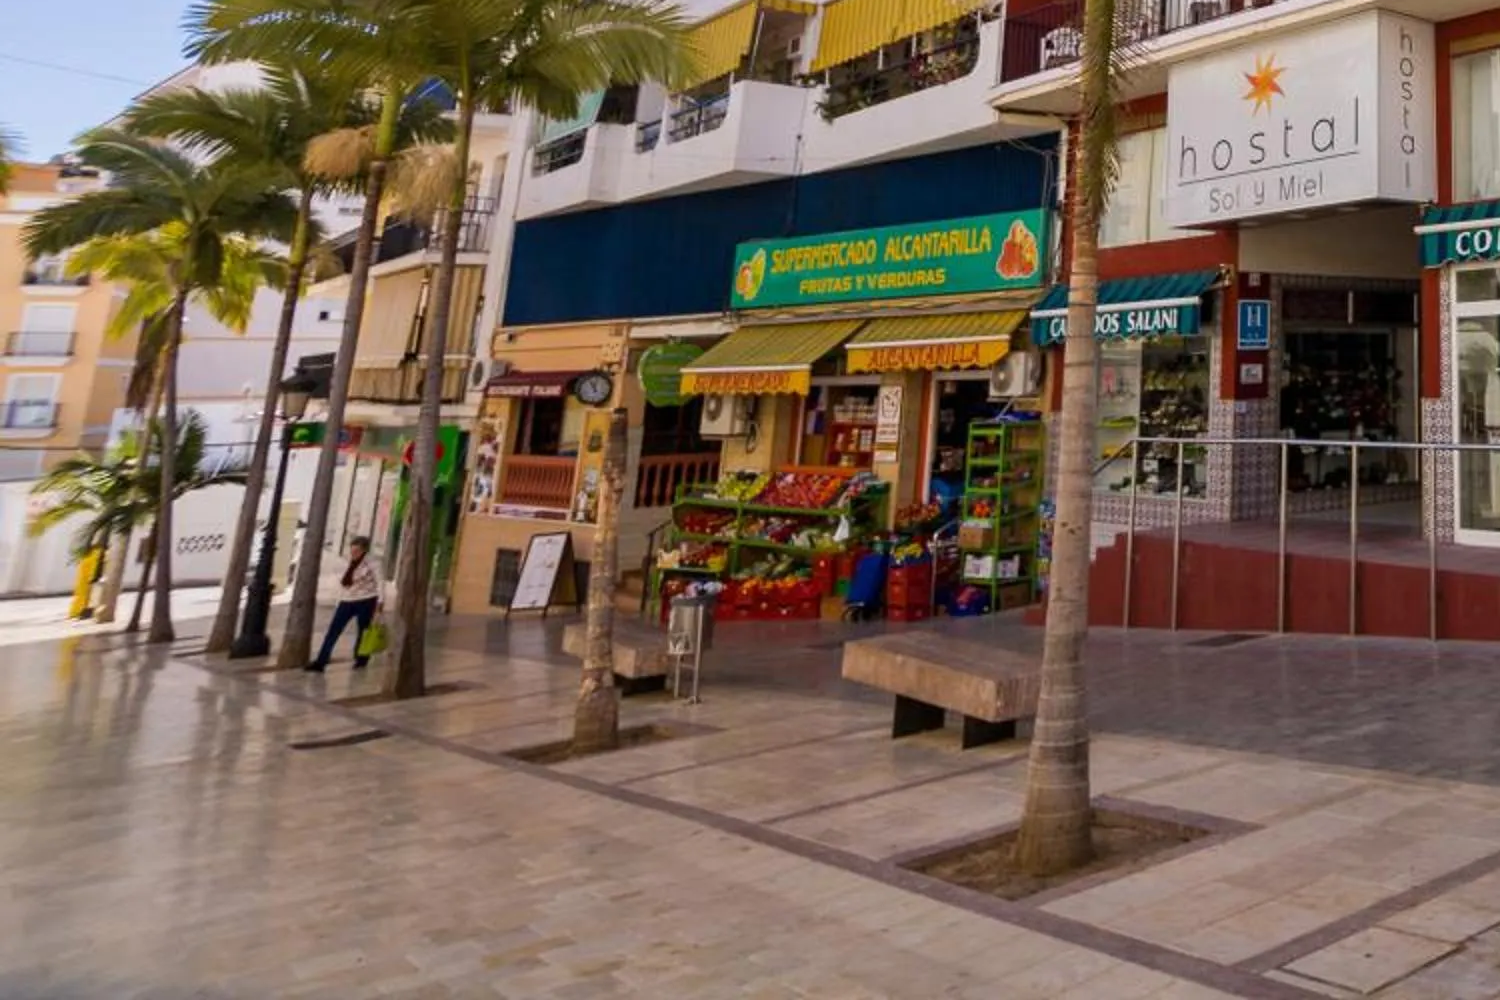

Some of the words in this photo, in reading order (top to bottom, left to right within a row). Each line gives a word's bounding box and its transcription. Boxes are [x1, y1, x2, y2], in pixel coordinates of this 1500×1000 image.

[1400, 25, 1415, 189] hostal
[1179, 95, 1360, 179] hostal
[1208, 183, 1241, 213] Sol
[1253, 178, 1266, 206] y
[1278, 169, 1324, 202] Miel
[770, 238, 877, 274] SUPERMERCADO
[883, 224, 993, 264] ALCANTARILLA
[800, 275, 853, 295] FRUTAS
[854, 274, 864, 291] Y
[866, 267, 946, 289] VERDURAS
[1127, 307, 1179, 333] SALANI
